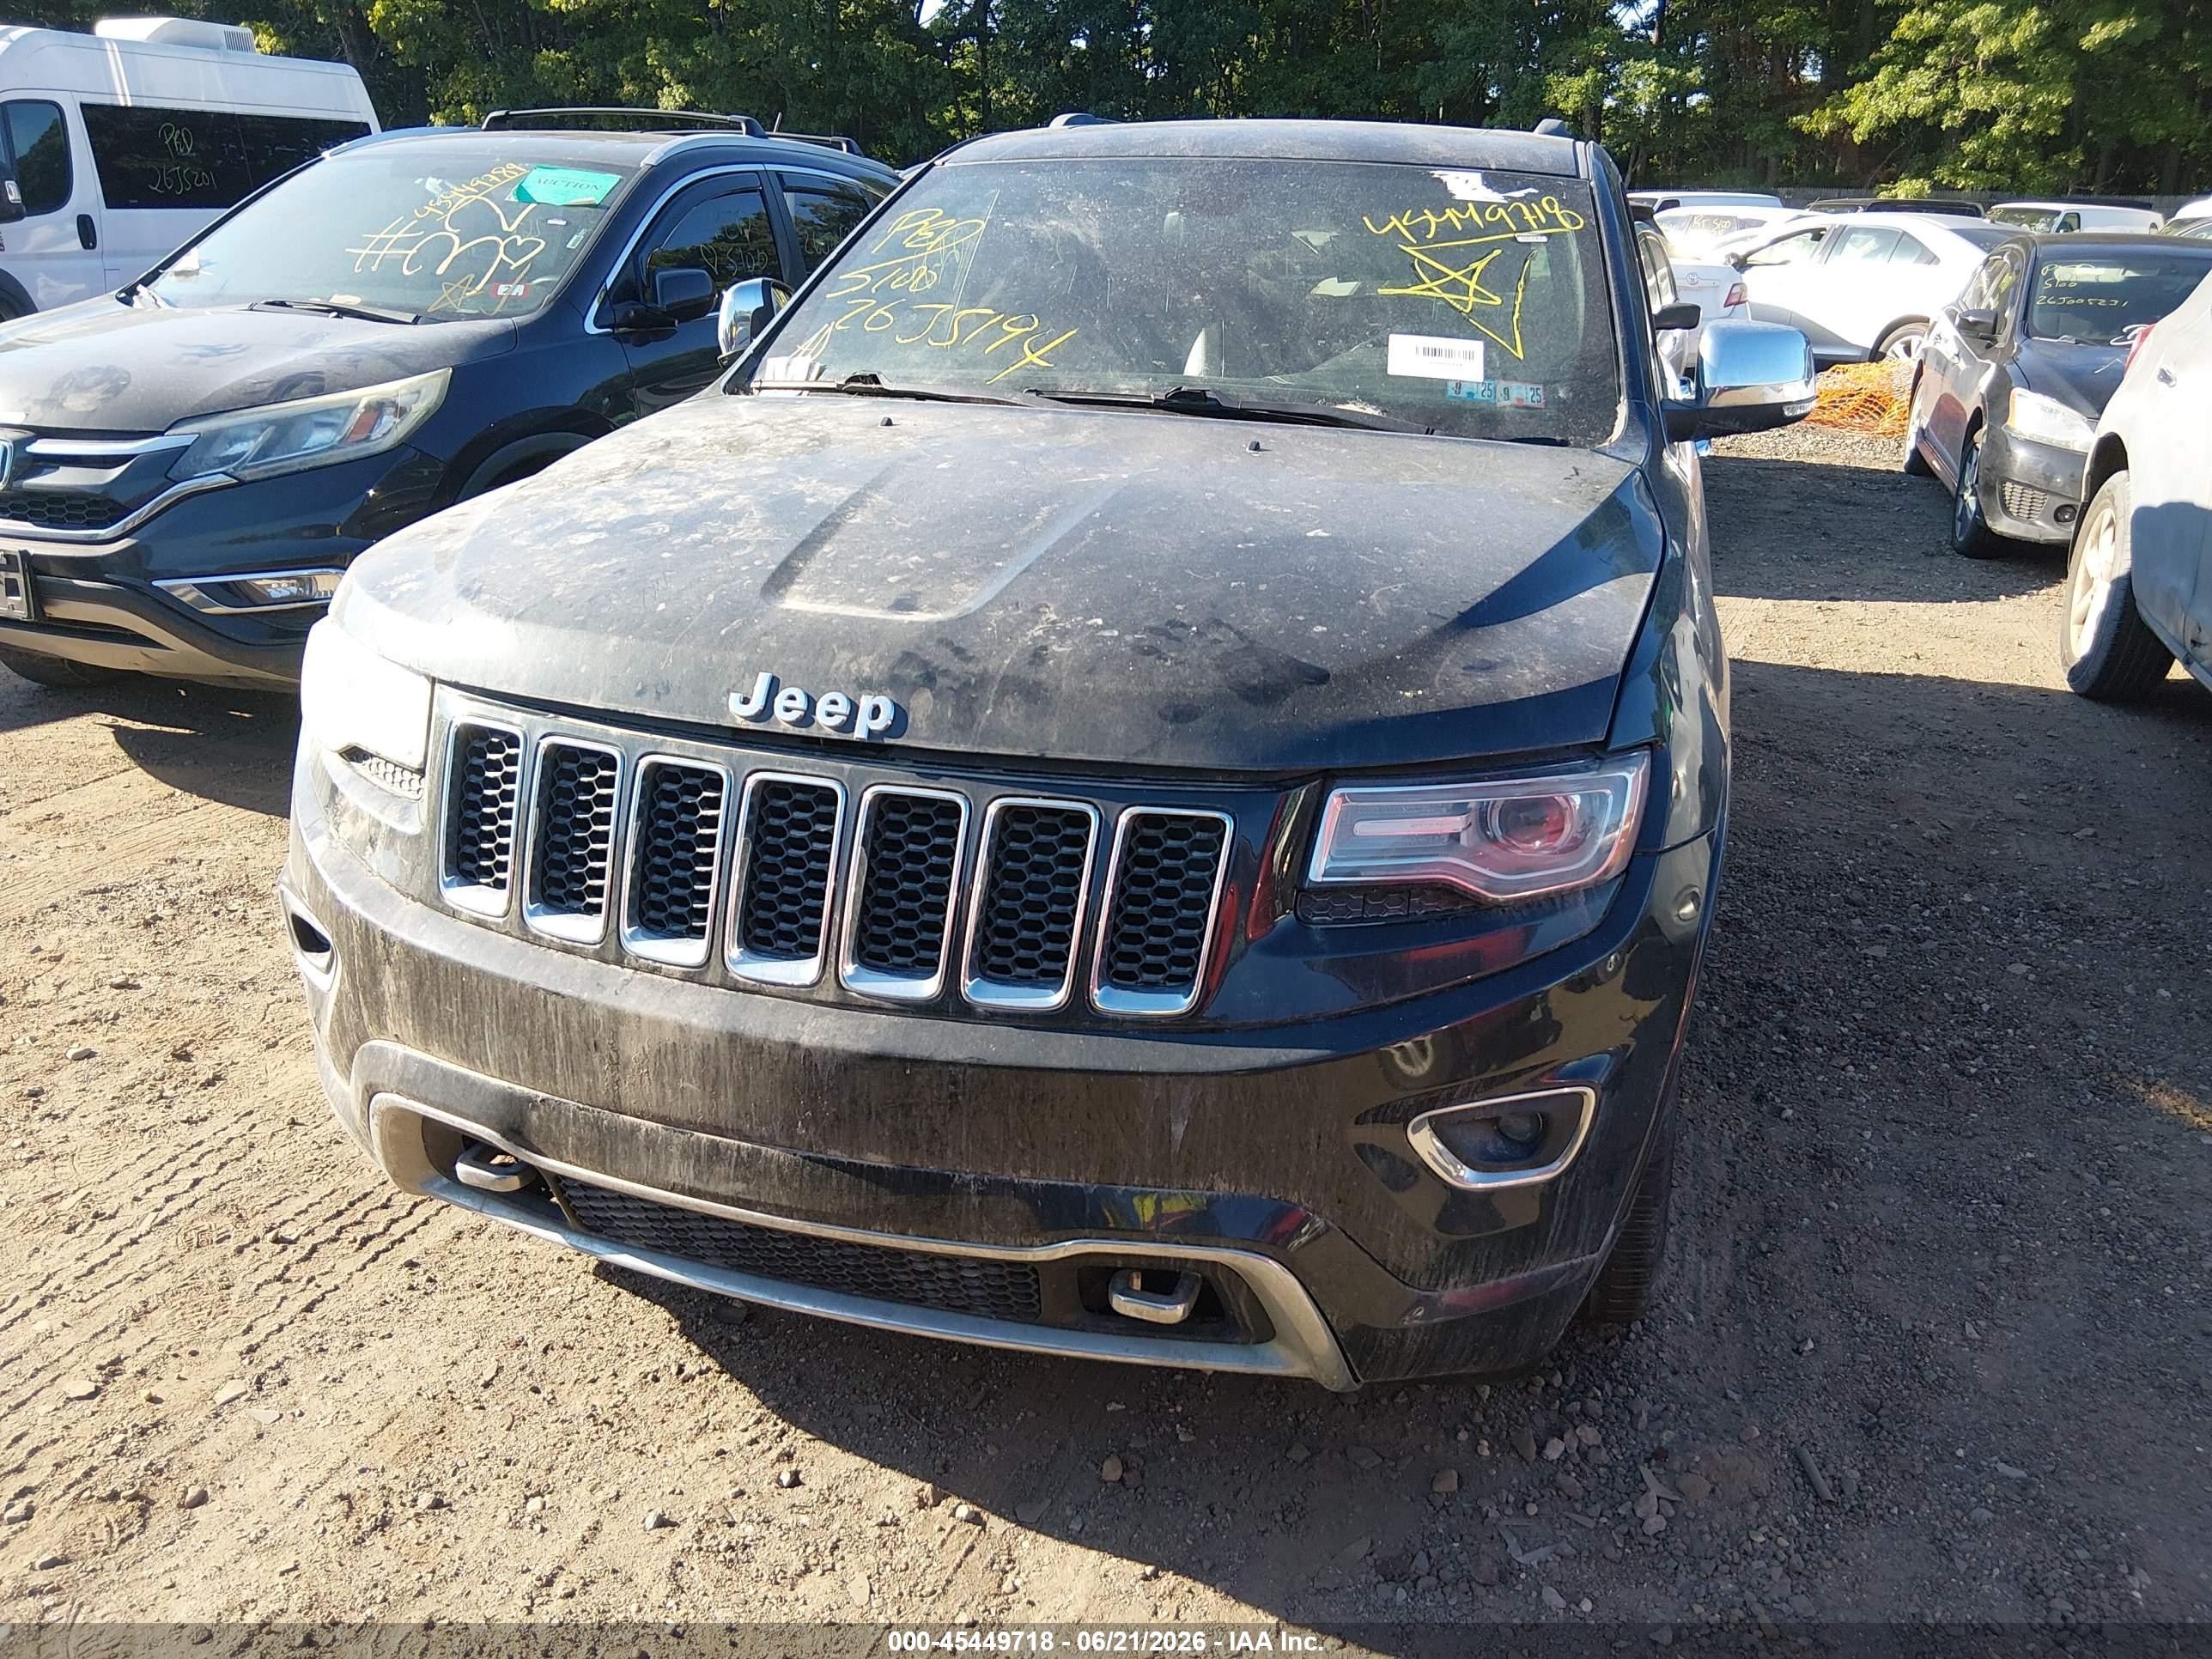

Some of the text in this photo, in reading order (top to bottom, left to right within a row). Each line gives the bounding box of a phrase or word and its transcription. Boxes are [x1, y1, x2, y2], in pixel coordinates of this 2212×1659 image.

[536, 177, 601, 191] AUCTION
[1480, 382, 1492, 398] 25
[1504, 387, 1542, 404] 9 25
[728, 672, 895, 740] Jeep
